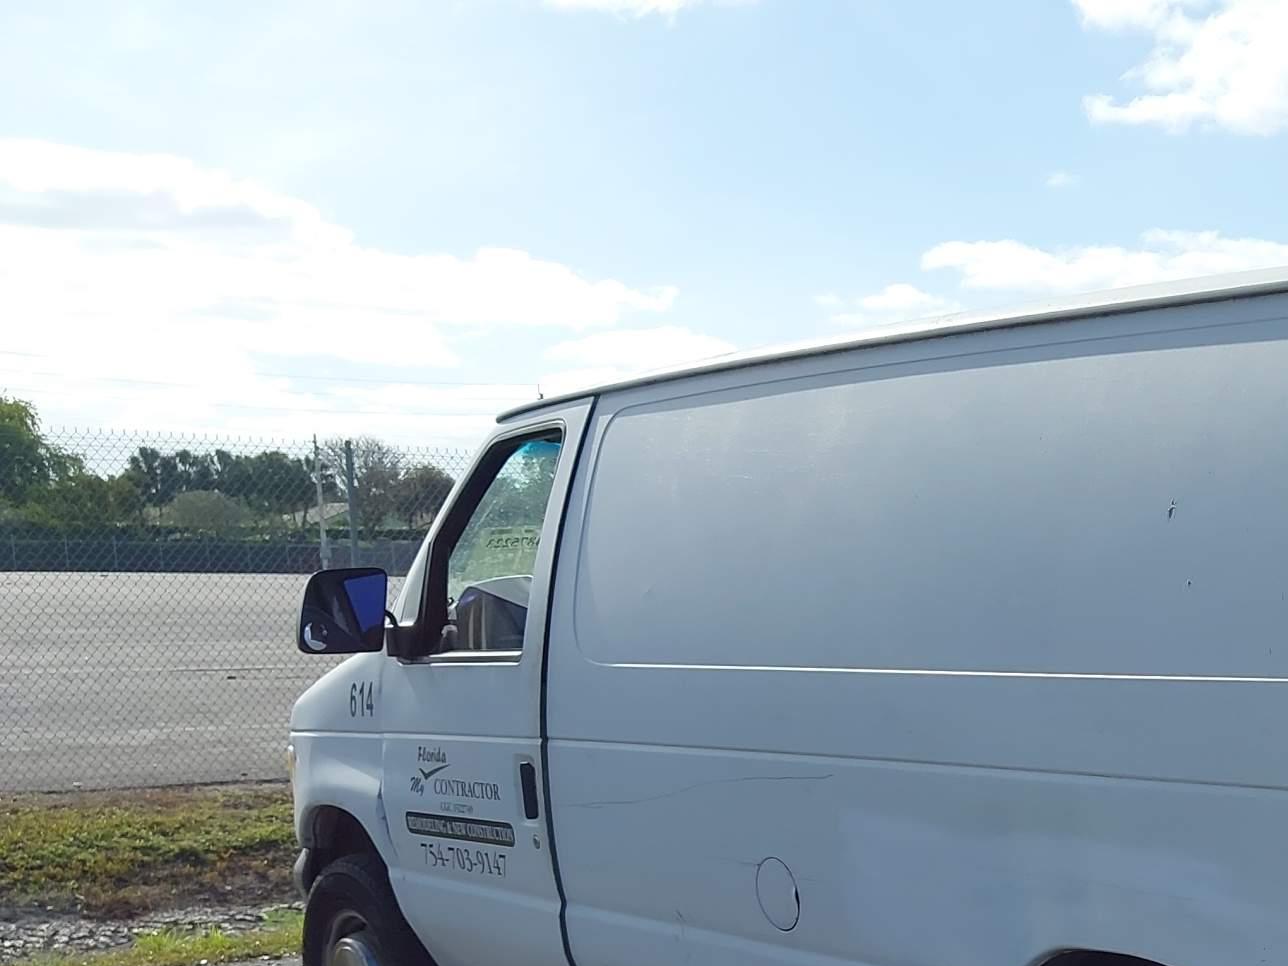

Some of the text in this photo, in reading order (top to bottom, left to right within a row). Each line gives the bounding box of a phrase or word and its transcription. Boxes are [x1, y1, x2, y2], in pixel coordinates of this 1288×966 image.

[350, 681, 374, 718] 614
[417, 745, 447, 764] Florida
[410, 776, 501, 801] My CONTRACTOR
[421, 842, 506, 878] 754-703-9147
